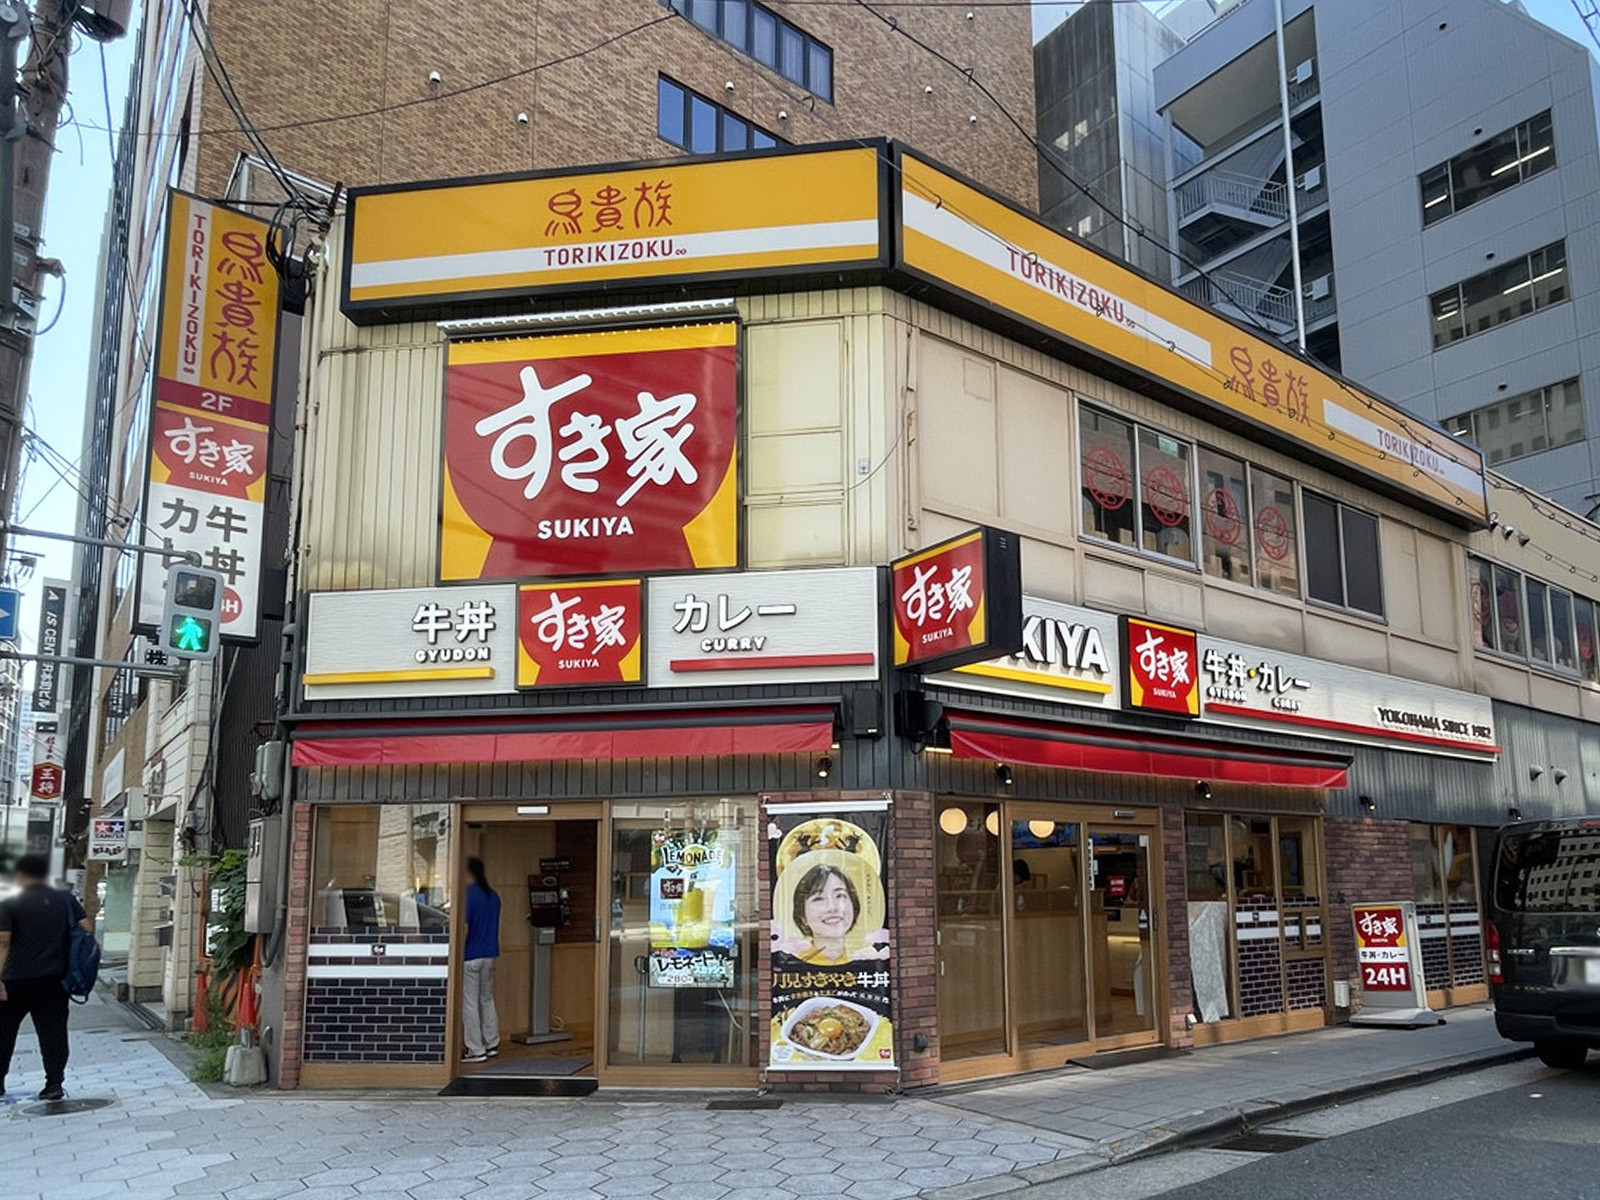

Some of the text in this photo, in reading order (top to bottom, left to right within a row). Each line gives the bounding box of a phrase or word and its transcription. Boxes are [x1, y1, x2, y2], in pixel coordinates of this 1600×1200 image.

[544, 239, 675, 267] TORIKIZOKU
[183, 213, 207, 366] TORIKIZOKU
[1006, 247, 1126, 324] TORIKIZOKU
[201, 391, 233, 412] 2F
[164, 417, 255, 477] すき家
[475, 366, 698, 507] すき家
[1377, 428, 1440, 473] TORIKIZOKU
[188, 471, 228, 486] SUKIYA
[203, 505, 248, 585] 牛丼
[537, 516, 634, 539] SUKIYA
[902, 564, 975, 627] すき家
[412, 600, 496, 645] 牛丼
[531, 592, 627, 655] すき家
[673, 594, 797, 635] カレー
[700, 636, 767, 653] CURRY
[922, 628, 954, 645] SUKIYA
[1015, 614, 1110, 673] KIYA
[415, 647, 491, 664] GYUDON
[557, 658, 600, 670] SUKIYA
[1136, 629, 1190, 687] すき家
[1153, 687, 1177, 699] SUKIYA
[1377, 706, 1441, 731] YOKOHAMA
[1441, 719, 1470, 737] SINCE
[1359, 911, 1399, 938] すき家
[1365, 967, 1406, 986] 24H
